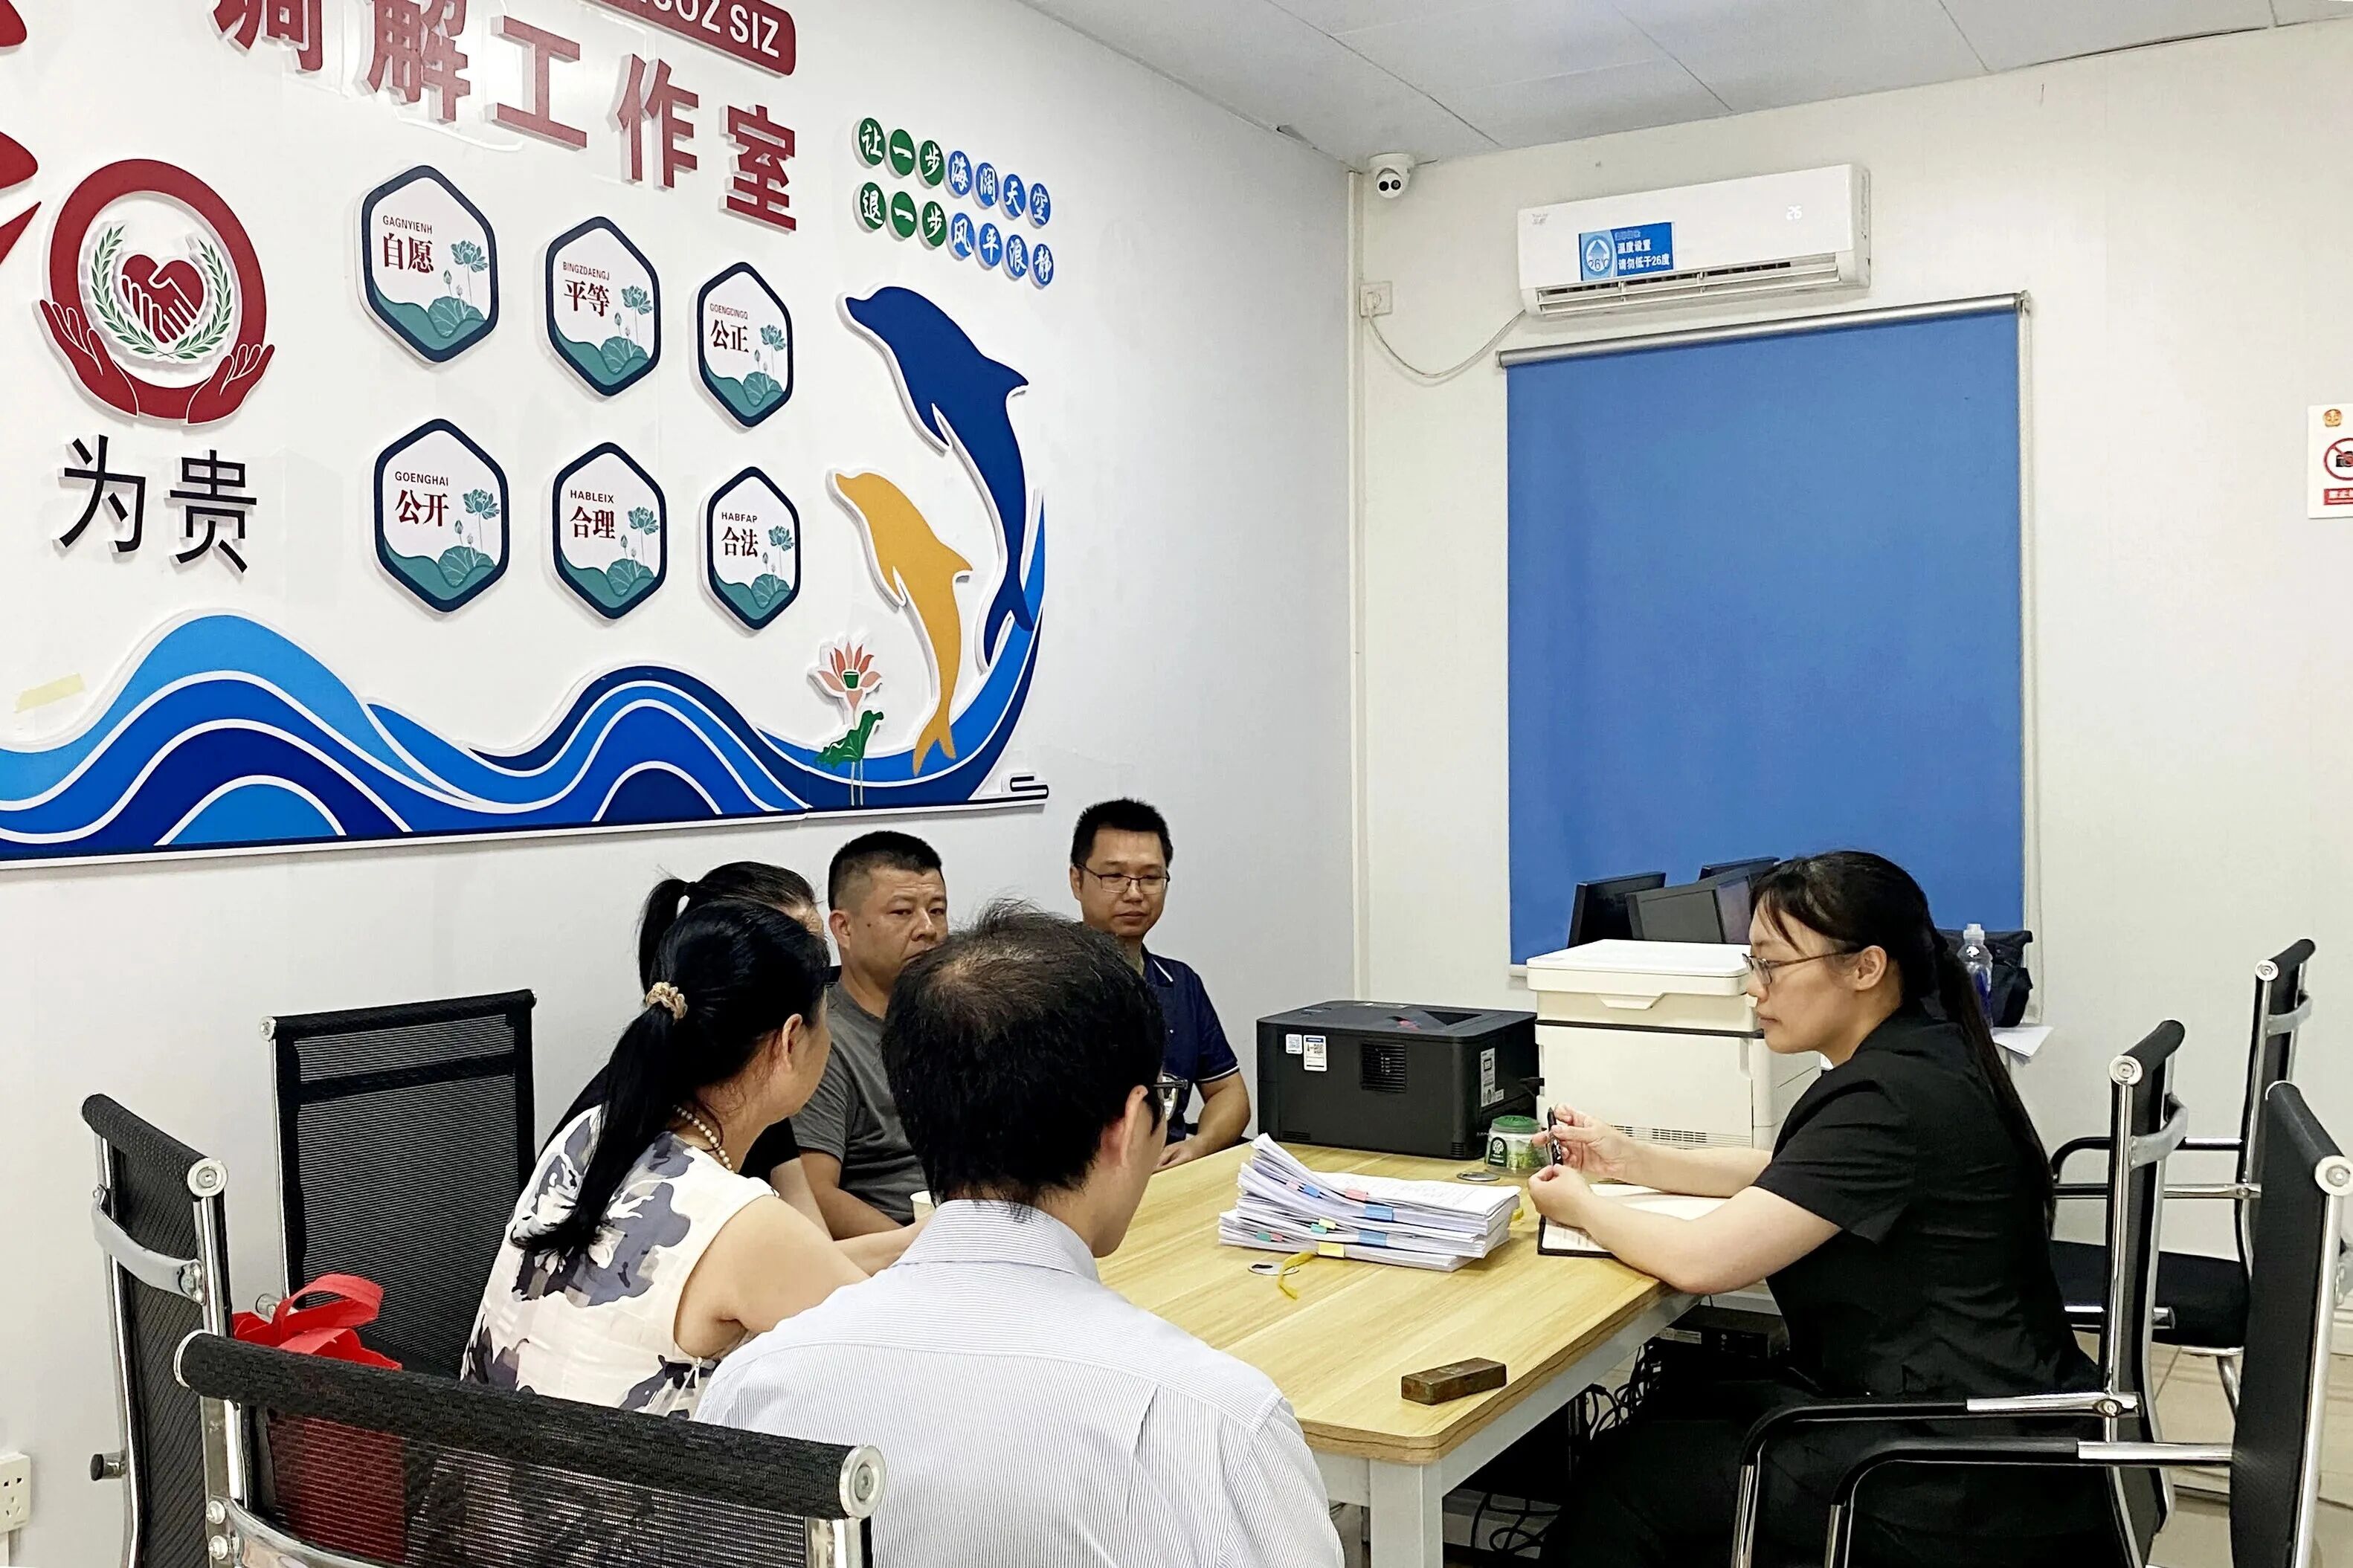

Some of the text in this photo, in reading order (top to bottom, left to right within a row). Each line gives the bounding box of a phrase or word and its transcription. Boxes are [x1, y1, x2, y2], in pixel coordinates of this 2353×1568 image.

[729, 4, 779, 57] SIZ
[382, 215, 433, 234] GAGNYIENH
[383, 232, 434, 274] 自愿
[563, 261, 610, 280] BINGZDAENGJ
[564, 279, 610, 317] 平等
[710, 319, 749, 353] 公正
[395, 471, 448, 486] GOENGHAI
[60, 434, 257, 573] 为贵
[394, 489, 449, 527] 公开
[570, 489, 614, 503] HABLEIX
[570, 506, 616, 539] 合理
[721, 512, 757, 523] HABFAP
[721, 526, 759, 558] 合法
